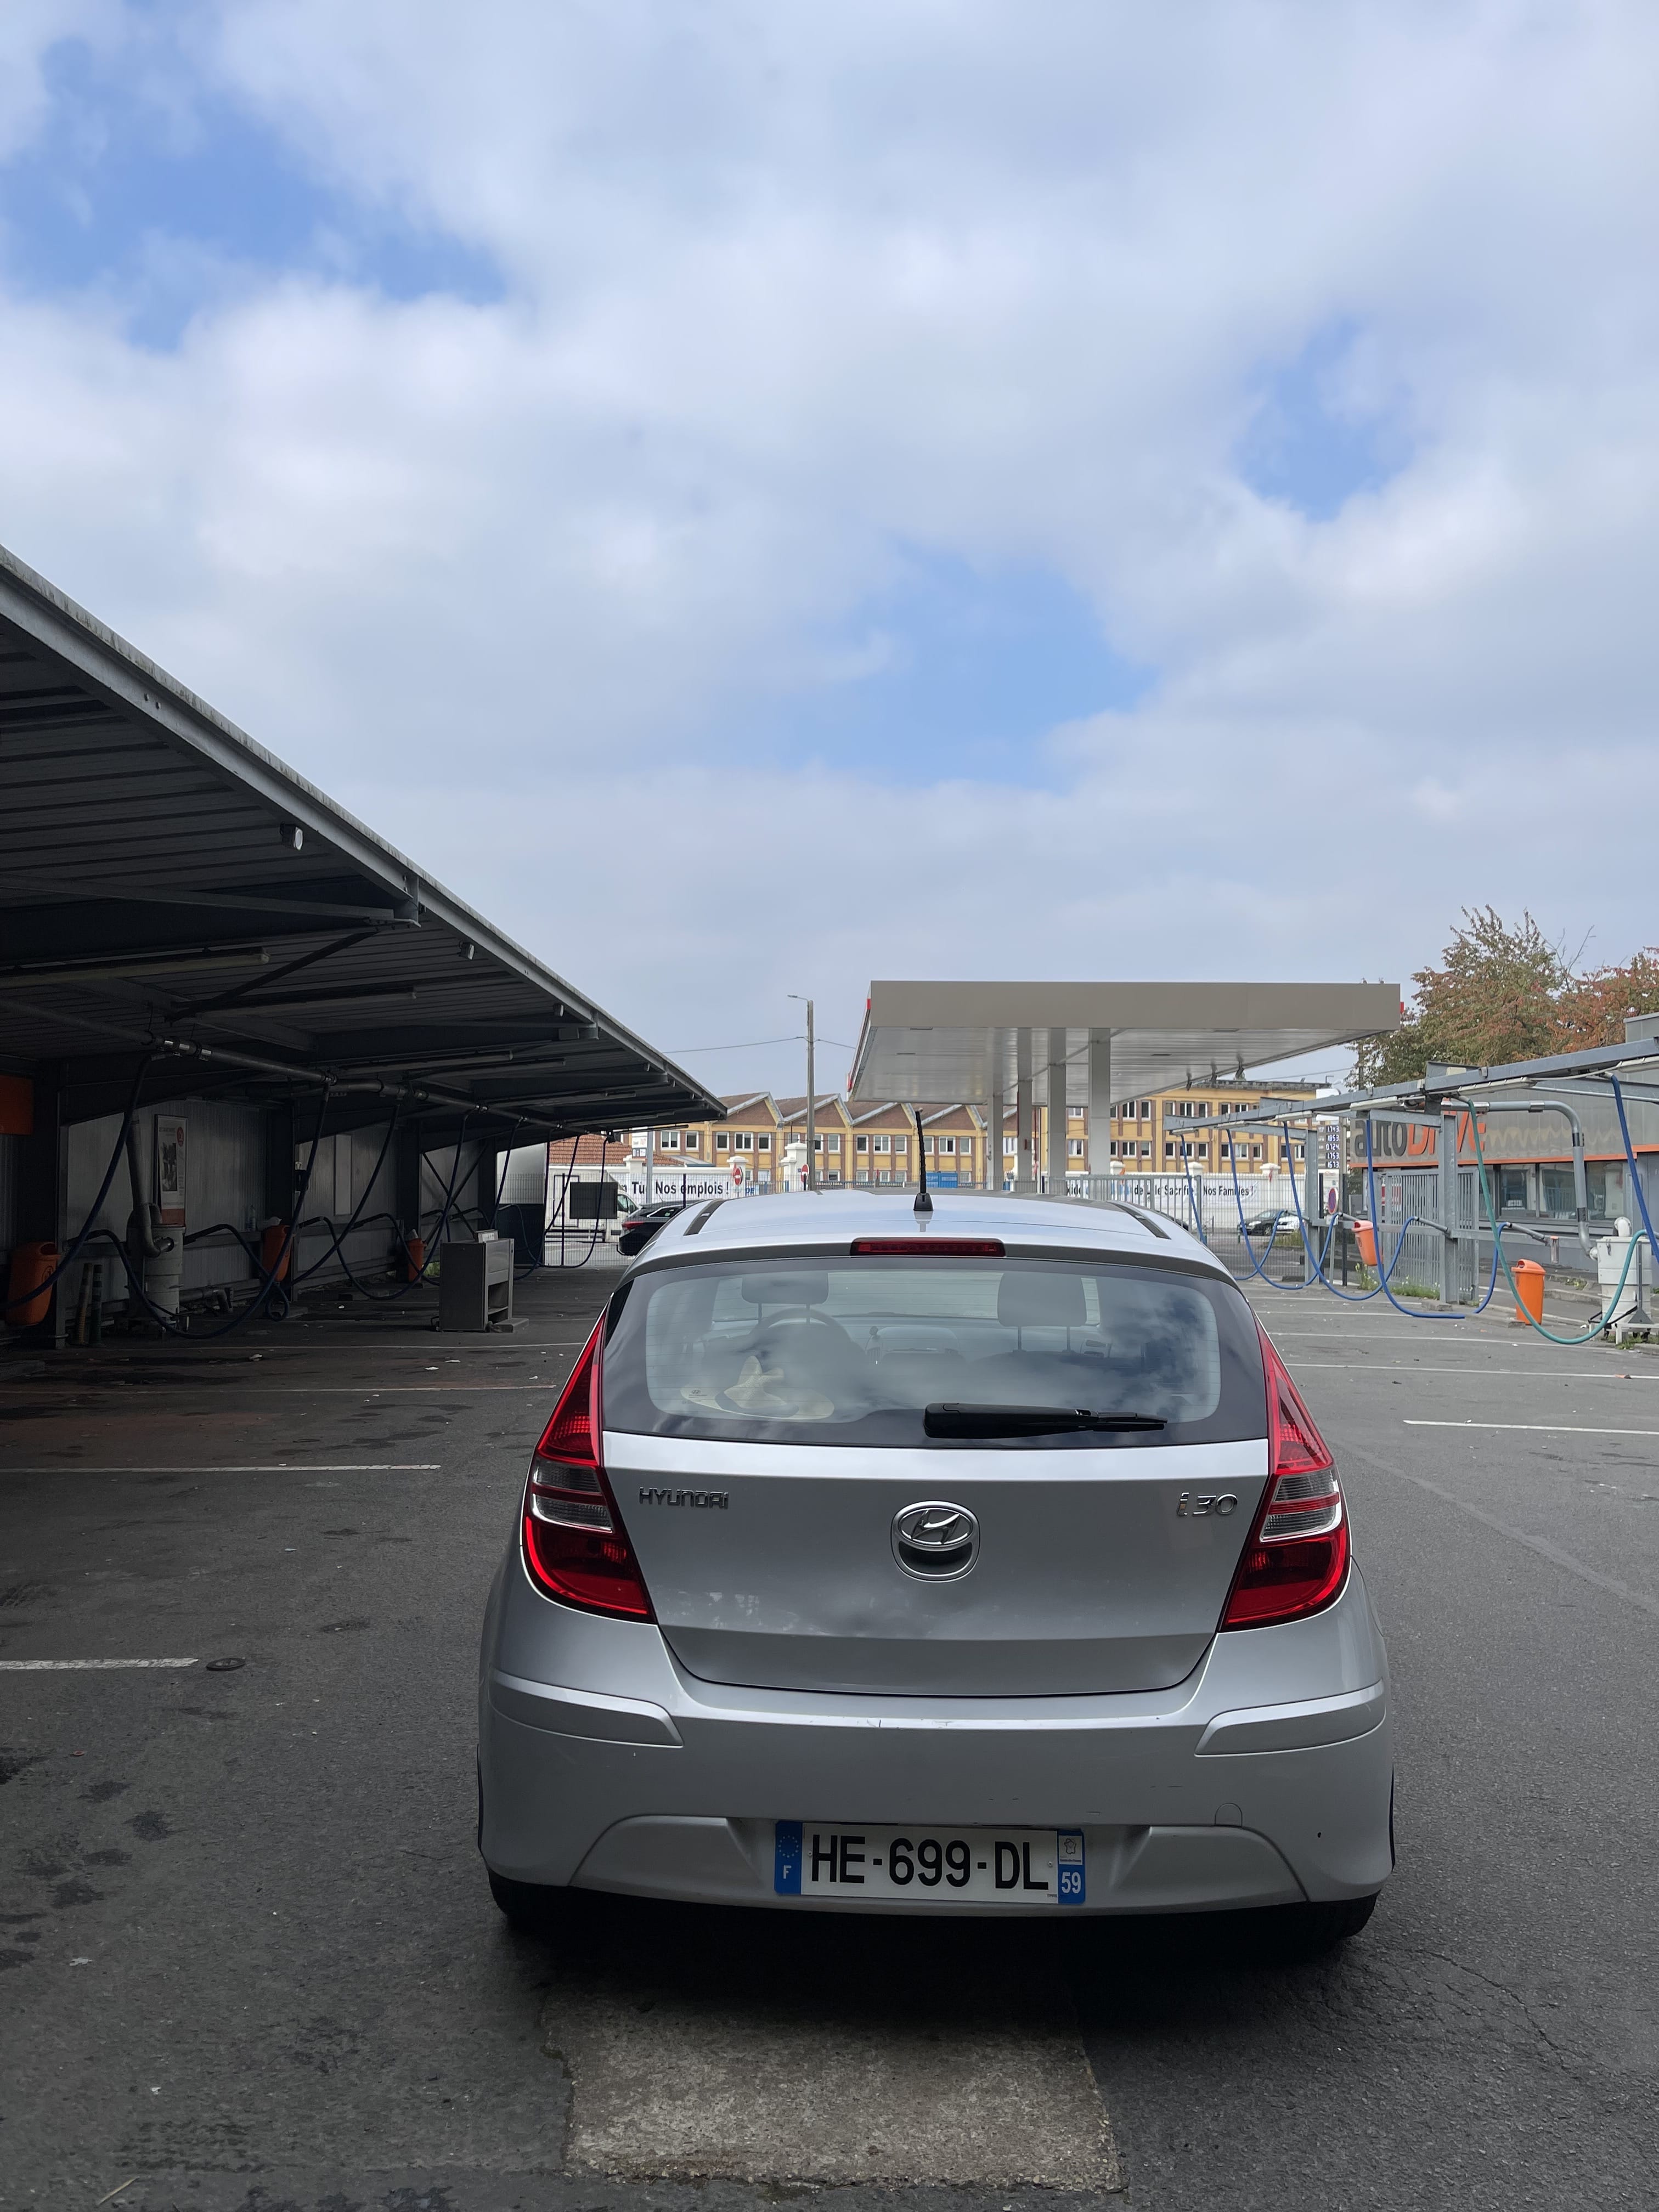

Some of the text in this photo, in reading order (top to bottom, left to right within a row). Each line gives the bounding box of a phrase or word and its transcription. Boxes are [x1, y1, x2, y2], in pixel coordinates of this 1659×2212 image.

[631, 1181, 648, 1194] Tu
[655, 1181, 676, 1194] Nos
[1203, 1186, 1216, 1196] Nos
[1218, 1186, 1249, 1196] Familes
[639, 1487, 729, 1509] HYUNDAI
[1177, 1492, 1238, 1516] i30
[783, 1865, 791, 1879] F
[811, 1834, 1049, 1890] HE-699-DL
[1061, 1871, 1082, 1894] 59
